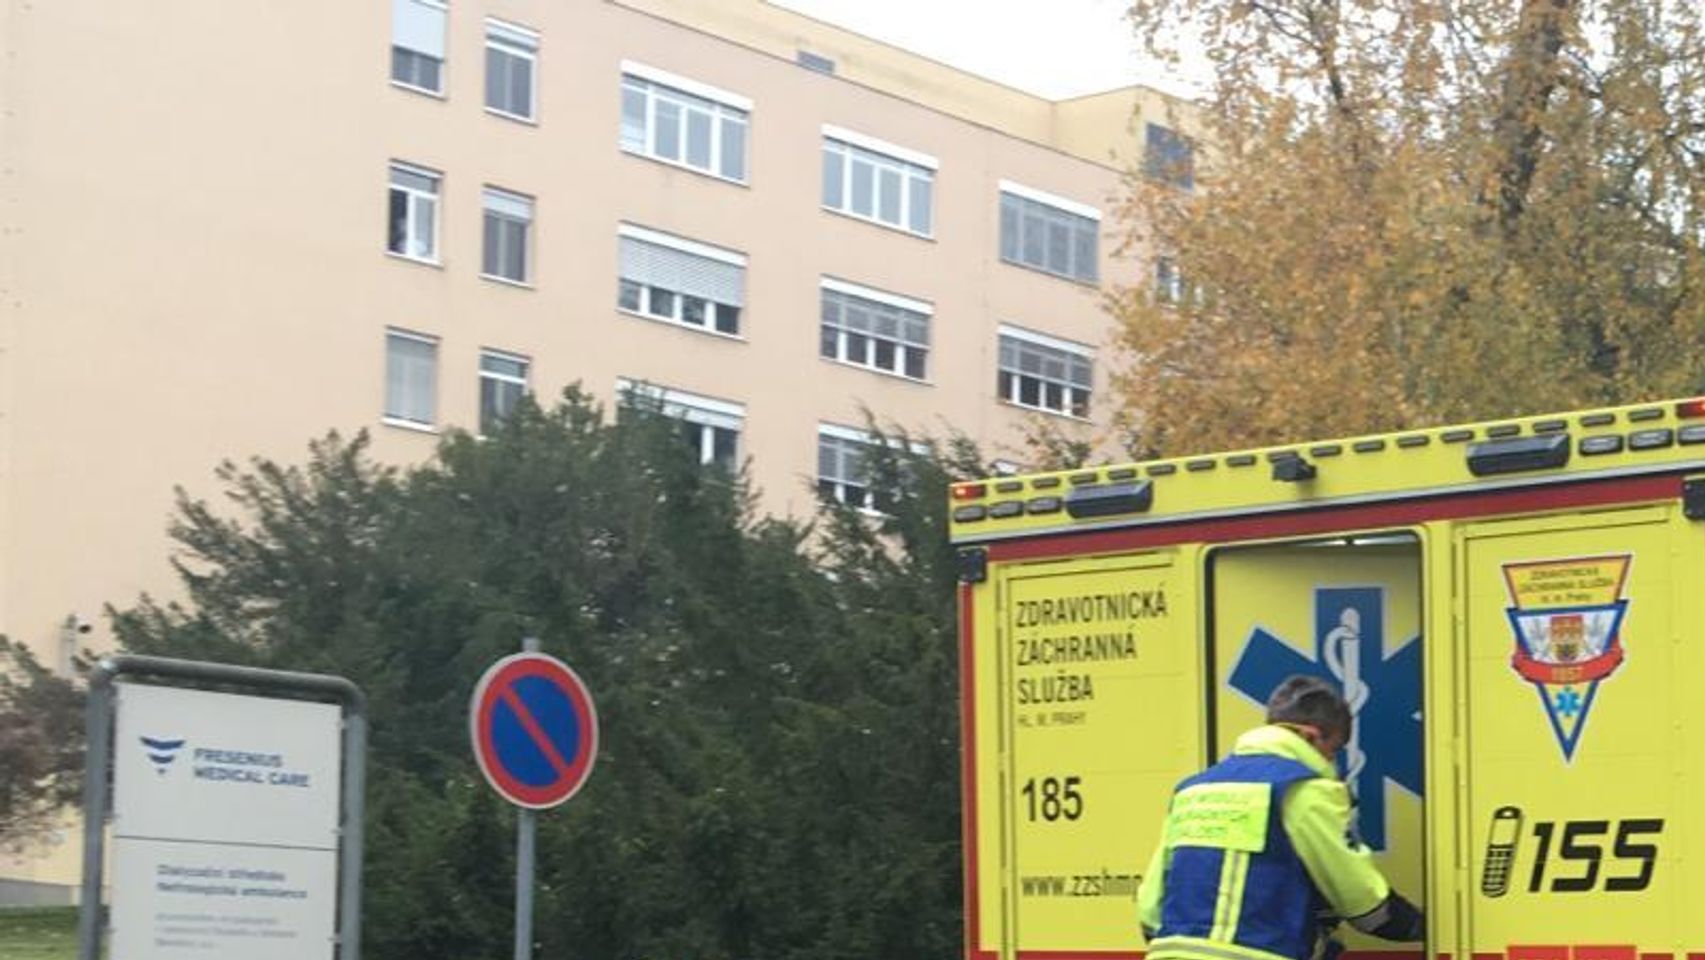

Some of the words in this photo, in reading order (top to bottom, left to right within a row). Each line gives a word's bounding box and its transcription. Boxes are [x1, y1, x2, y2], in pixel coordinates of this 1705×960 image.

[1015, 582, 1168, 628] ZDRAVOTNICKÁ
[1016, 624, 1138, 667] ZÁCHRANNÁ
[1017, 669, 1094, 705] SLUŽBA
[193, 765, 265, 784] MEDICAL
[1021, 775, 1084, 823] 185
[1527, 818, 1666, 893] 155
